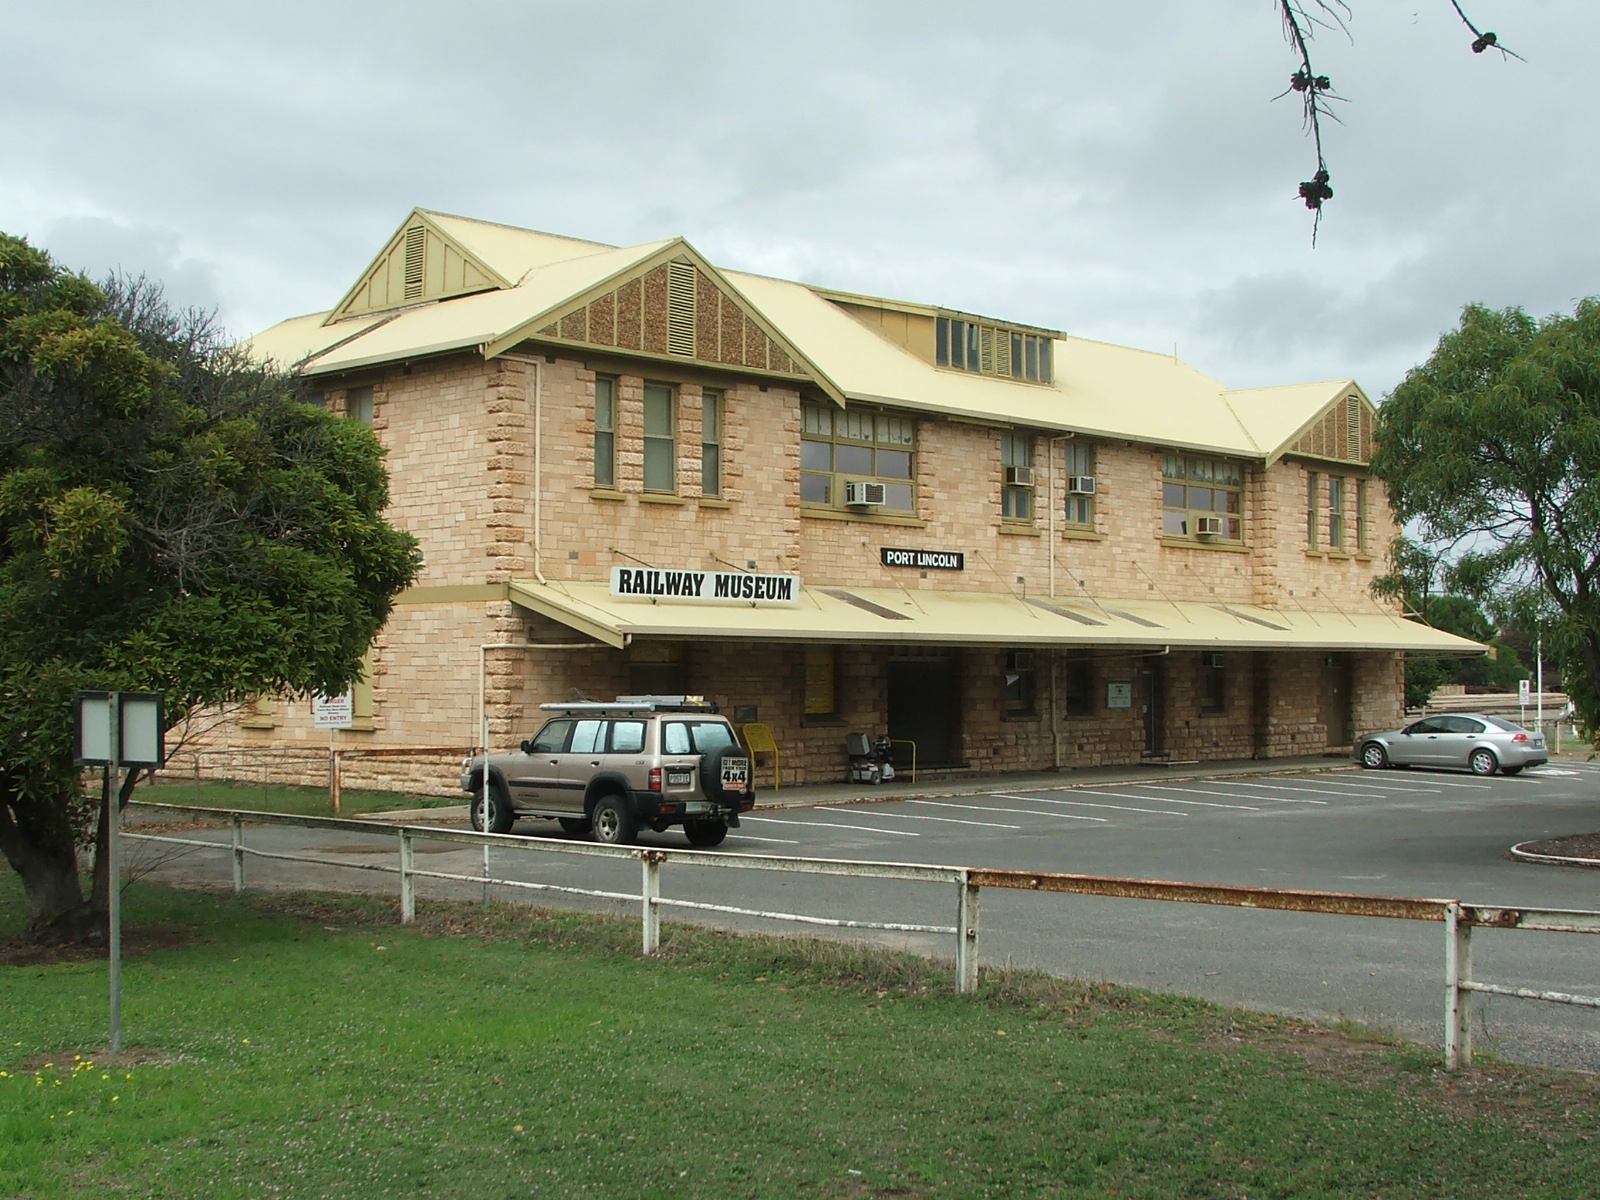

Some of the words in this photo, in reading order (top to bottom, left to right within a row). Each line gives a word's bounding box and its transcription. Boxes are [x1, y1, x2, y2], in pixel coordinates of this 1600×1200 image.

[887, 551, 915, 565] PORT
[917, 553, 957, 567] LINCOLN
[619, 569, 705, 597] RAILWAY
[714, 574, 792, 600] MUSEUM
